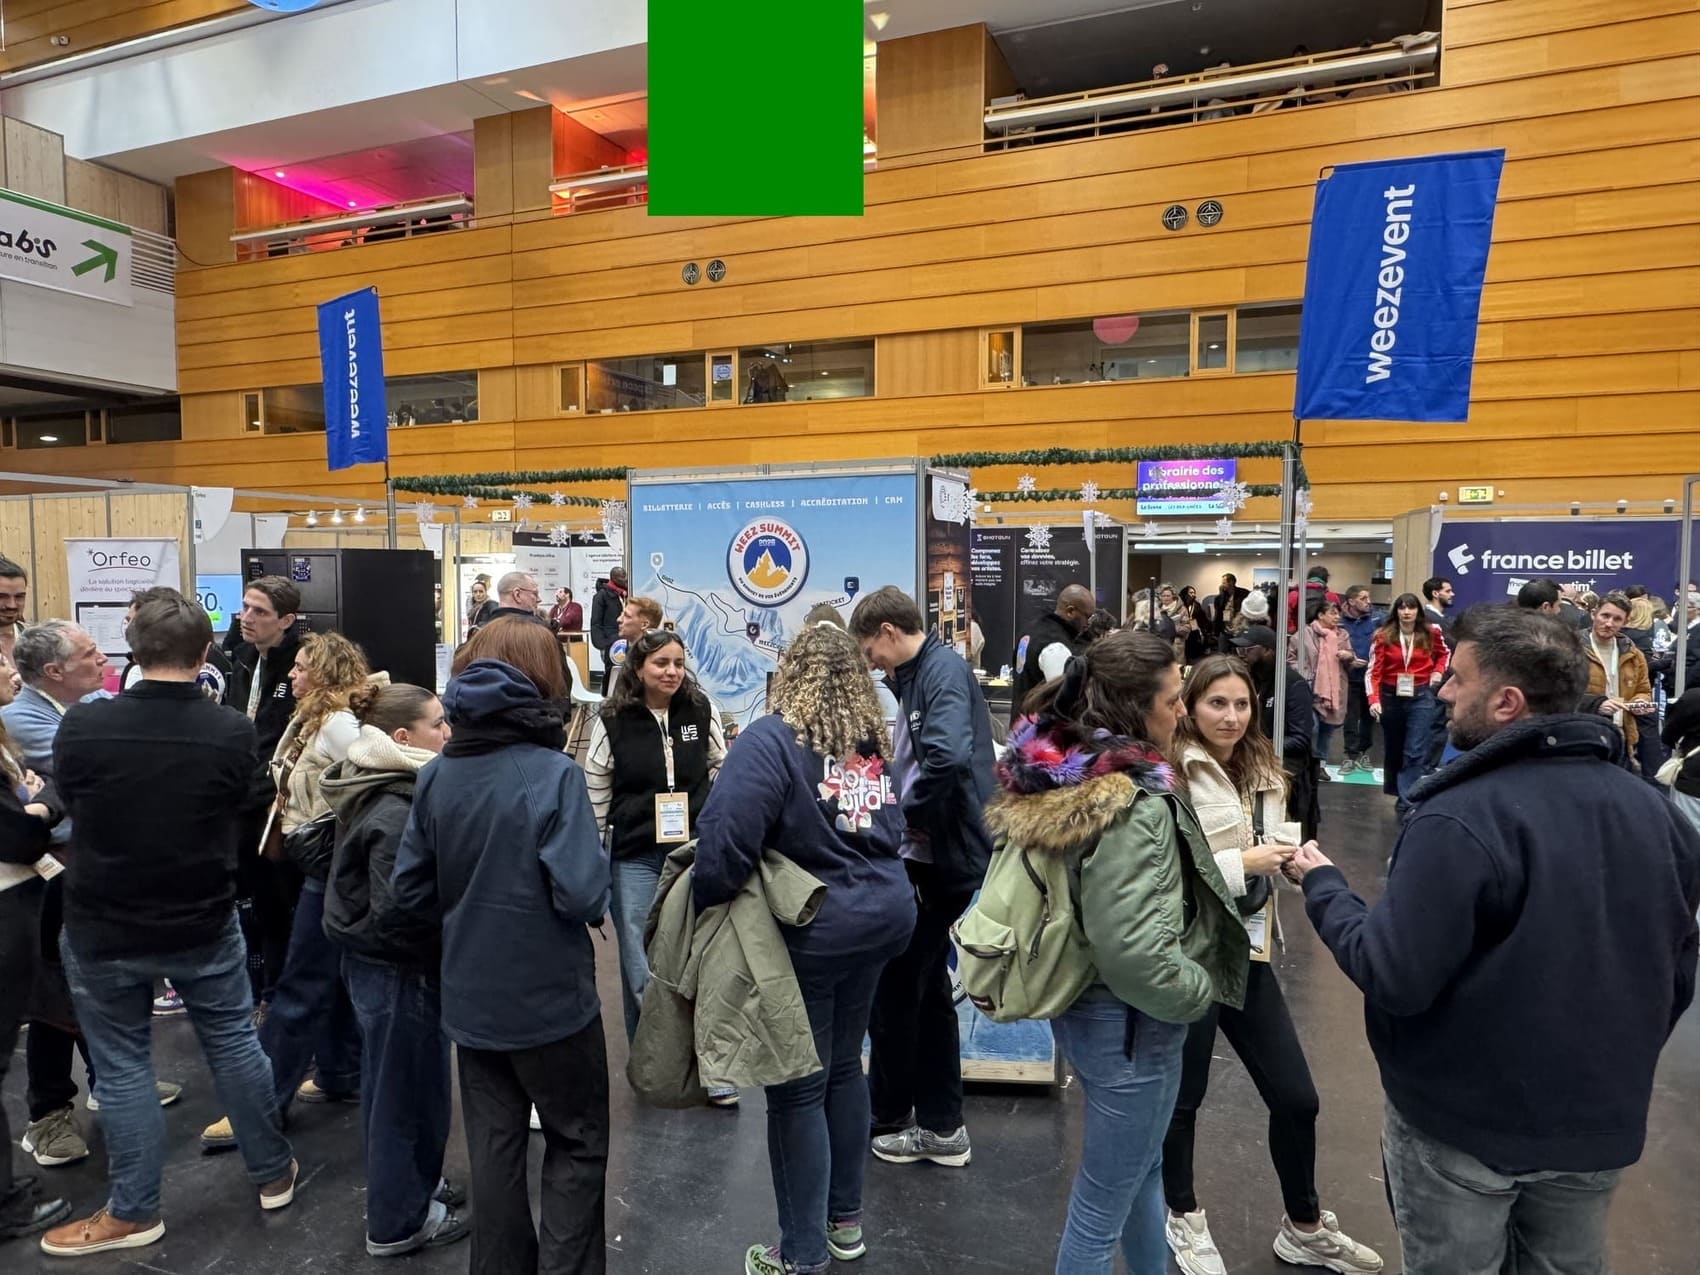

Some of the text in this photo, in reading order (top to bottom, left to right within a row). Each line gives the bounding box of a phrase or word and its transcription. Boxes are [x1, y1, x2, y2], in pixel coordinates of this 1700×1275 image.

[24, 256, 58, 271] transition
[1365, 183, 1416, 385] weezevent
[344, 308, 361, 439] weezevent
[1202, 465, 1225, 476] des
[642, 496, 903, 513] BILLETTERIE ACCÈS CASHLESS ACCRÉDITATION CRM
[734, 523, 800, 553] WEEZ SUMMIT
[92, 551, 151, 567] Orfeo
[1481, 549, 1633, 570] france billet
